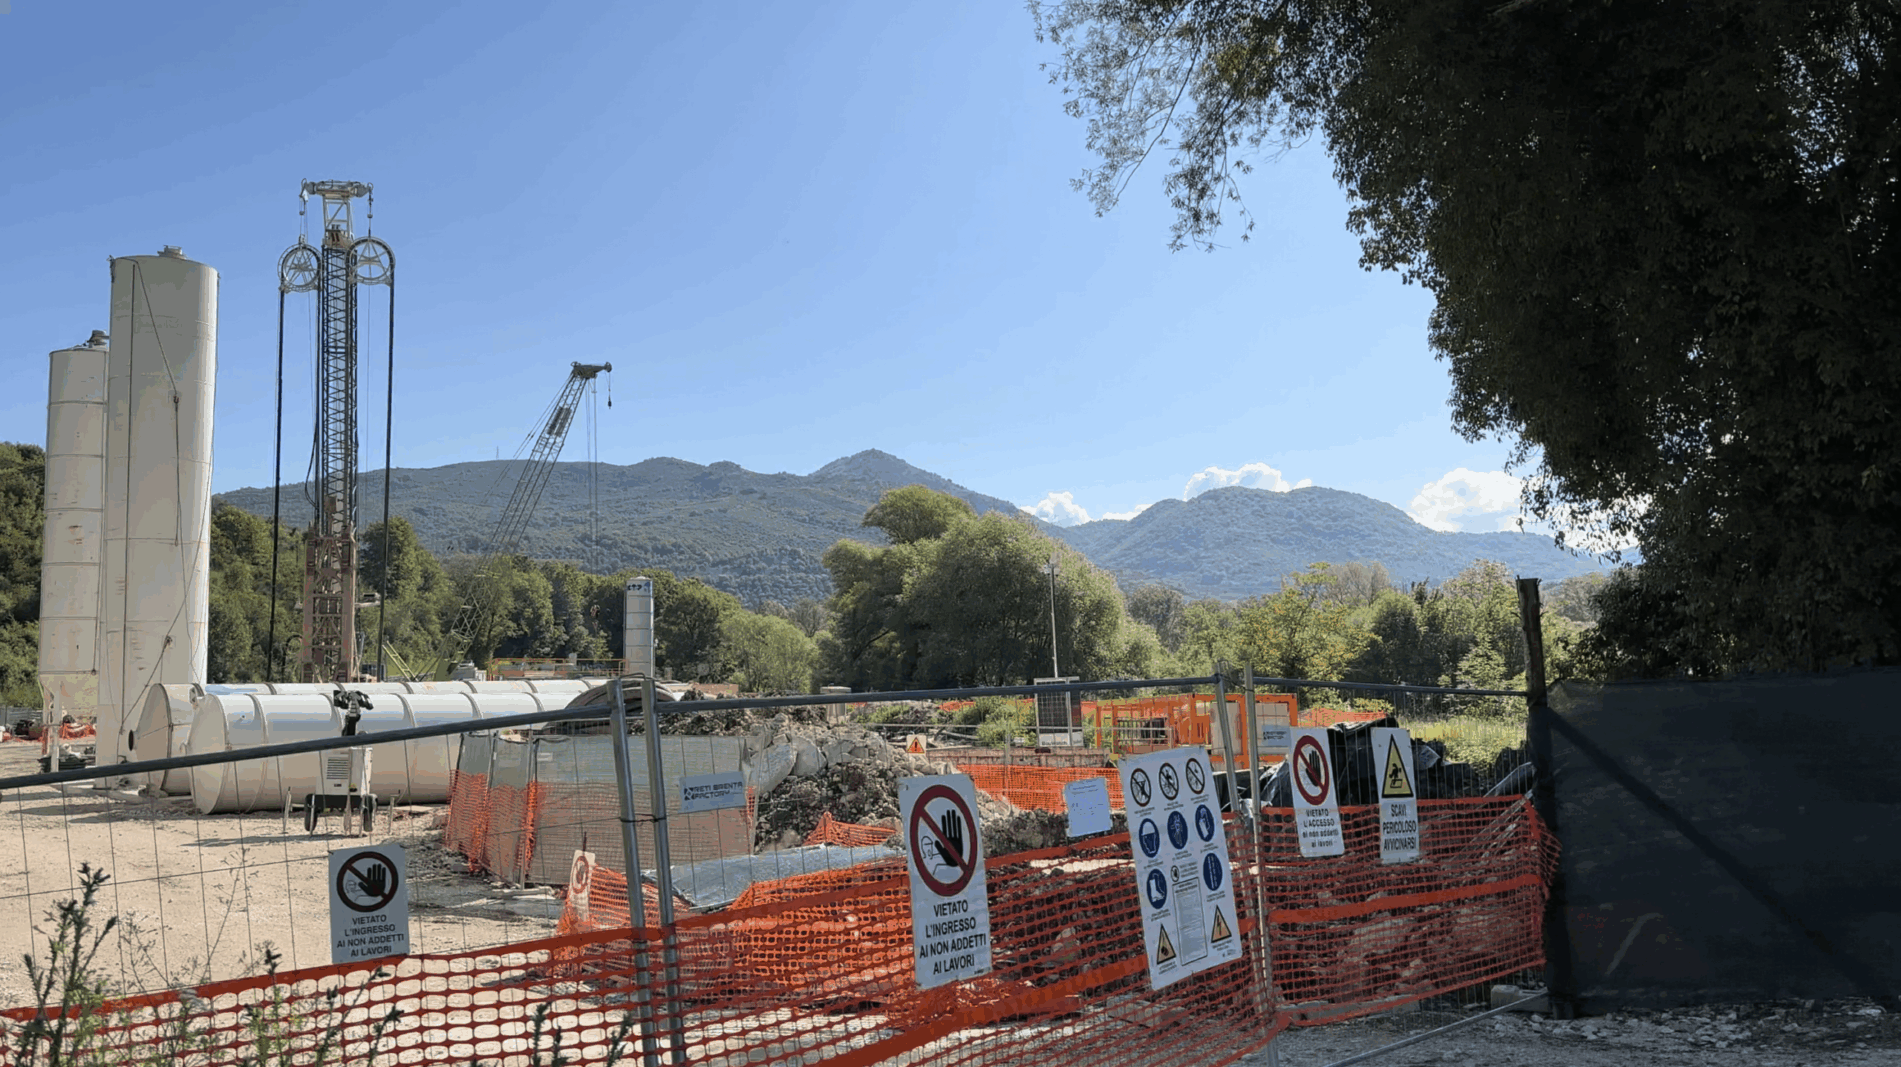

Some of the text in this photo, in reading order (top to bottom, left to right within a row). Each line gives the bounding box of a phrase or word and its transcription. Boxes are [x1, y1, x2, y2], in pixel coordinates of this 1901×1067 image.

[1306, 808, 1329, 816] VIETATO
[1391, 804, 1407, 817] SCAVI
[1303, 818, 1335, 828] L'ACCESSO
[1383, 820, 1417, 835] PERICOLOSO
[1384, 836, 1417, 851] AVVICINARSI
[933, 899, 968, 917] VIETATO
[352, 914, 387, 925] VIETATO
[925, 916, 976, 938] L'INGRESSO
[344, 923, 396, 937] L'INGRESSO
[336, 933, 404, 948] AI NON ADDETTI
[919, 932, 986, 959] AI NON ADDETTI
[350, 945, 392, 957] AI LAVORI
[933, 960, 942, 975] AI
[943, 953, 975, 973] LAVORI
